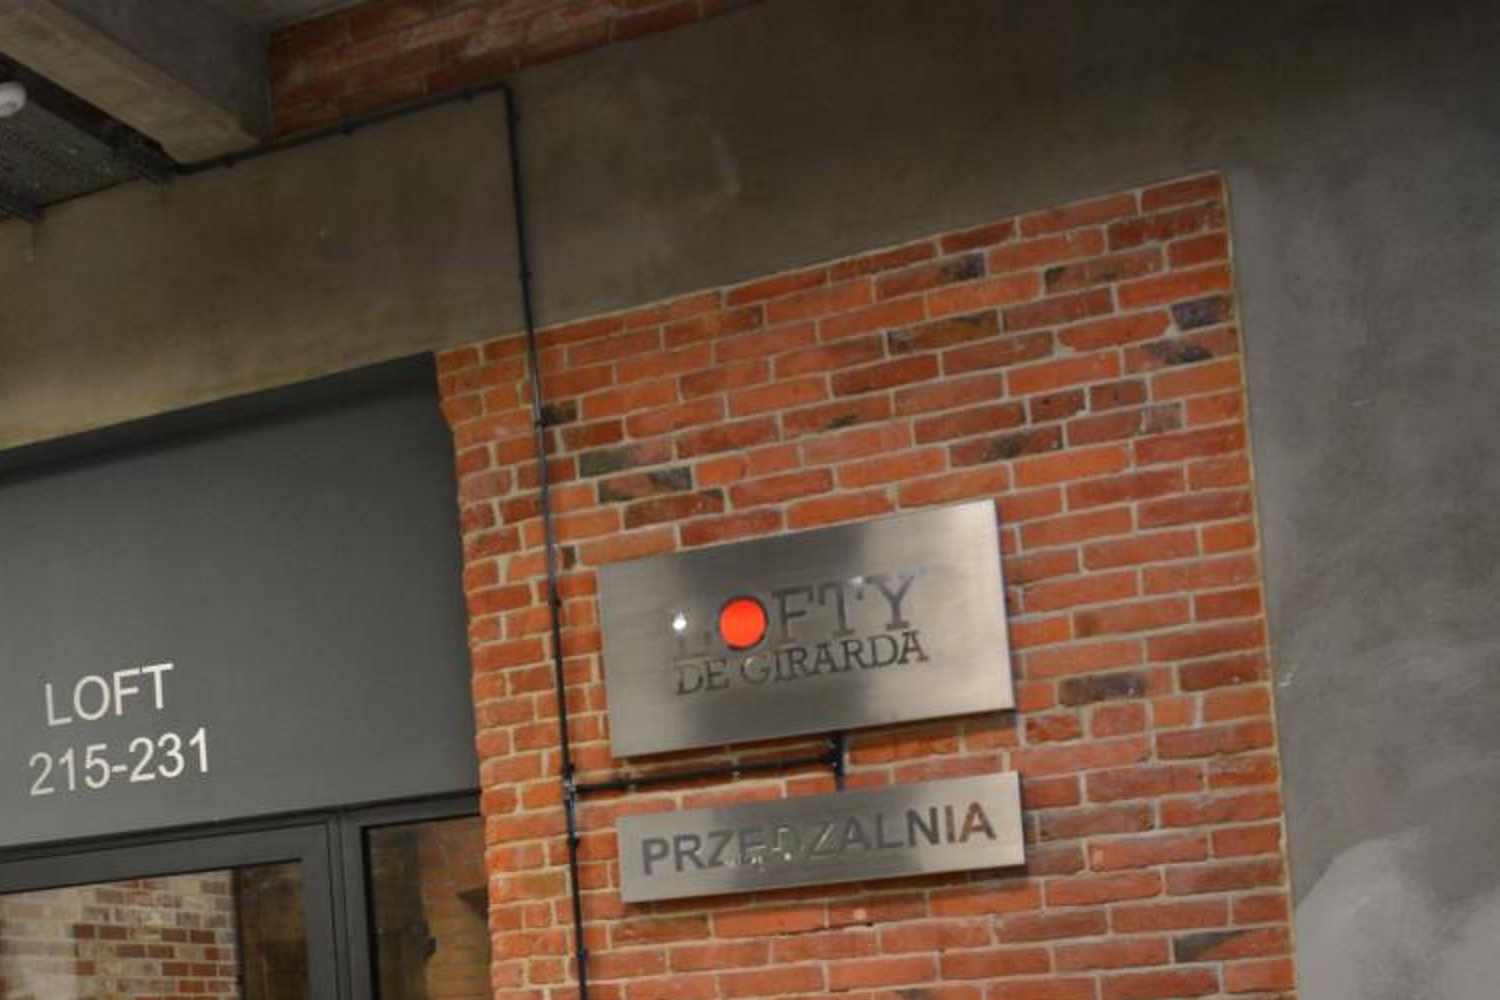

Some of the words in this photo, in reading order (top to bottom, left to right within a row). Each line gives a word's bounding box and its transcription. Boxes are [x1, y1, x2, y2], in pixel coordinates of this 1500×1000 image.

[45, 662, 174, 727] LOFT
[674, 658, 730, 696] DE
[740, 629, 930, 685] GIRARDA
[28, 727, 209, 796] 215-231
